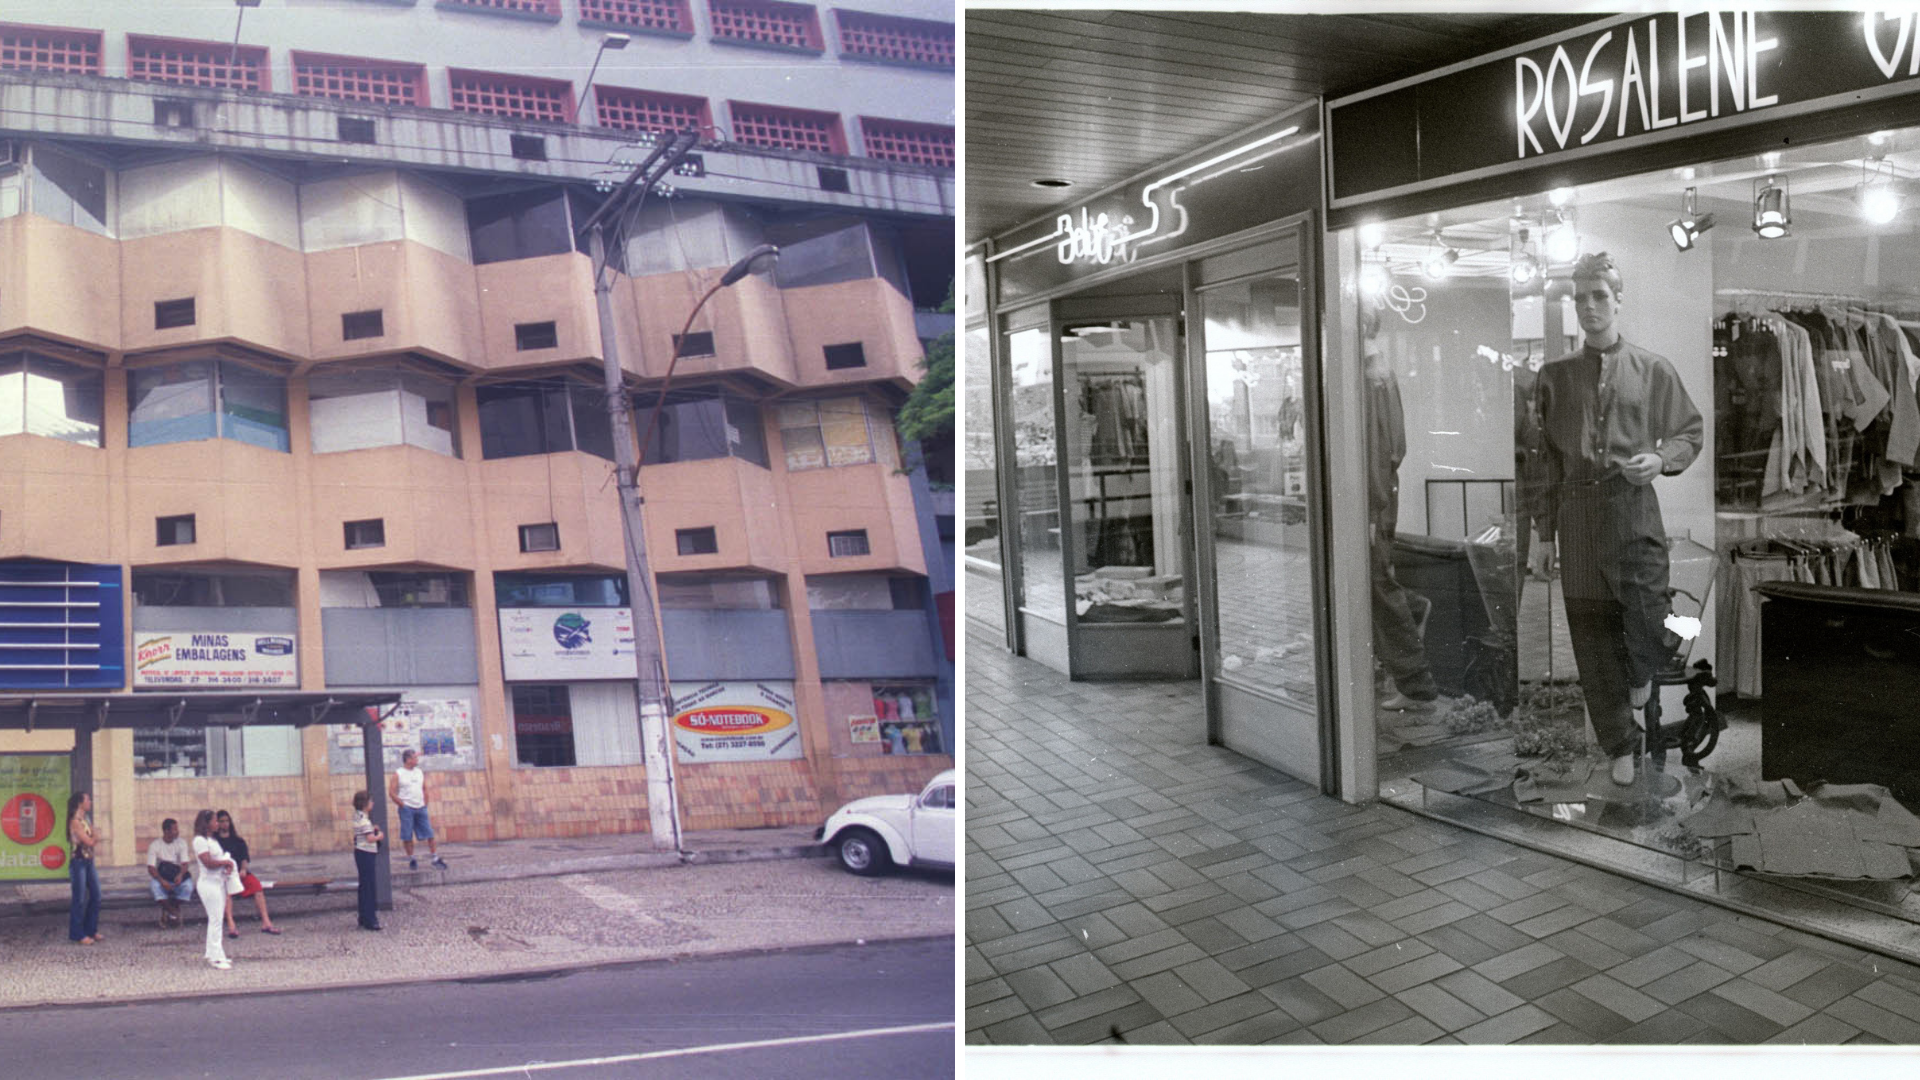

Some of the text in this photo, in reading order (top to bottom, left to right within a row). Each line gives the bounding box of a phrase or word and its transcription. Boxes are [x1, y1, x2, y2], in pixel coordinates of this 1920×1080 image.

[1516, 11, 1778, 158] ROSALENE
[192, 634, 229, 647] MINAS
[138, 643, 170, 662] Knorr
[176, 648, 246, 661] EMBALAGENS
[689, 712, 763, 726] SÓ-NOTEBOOK
